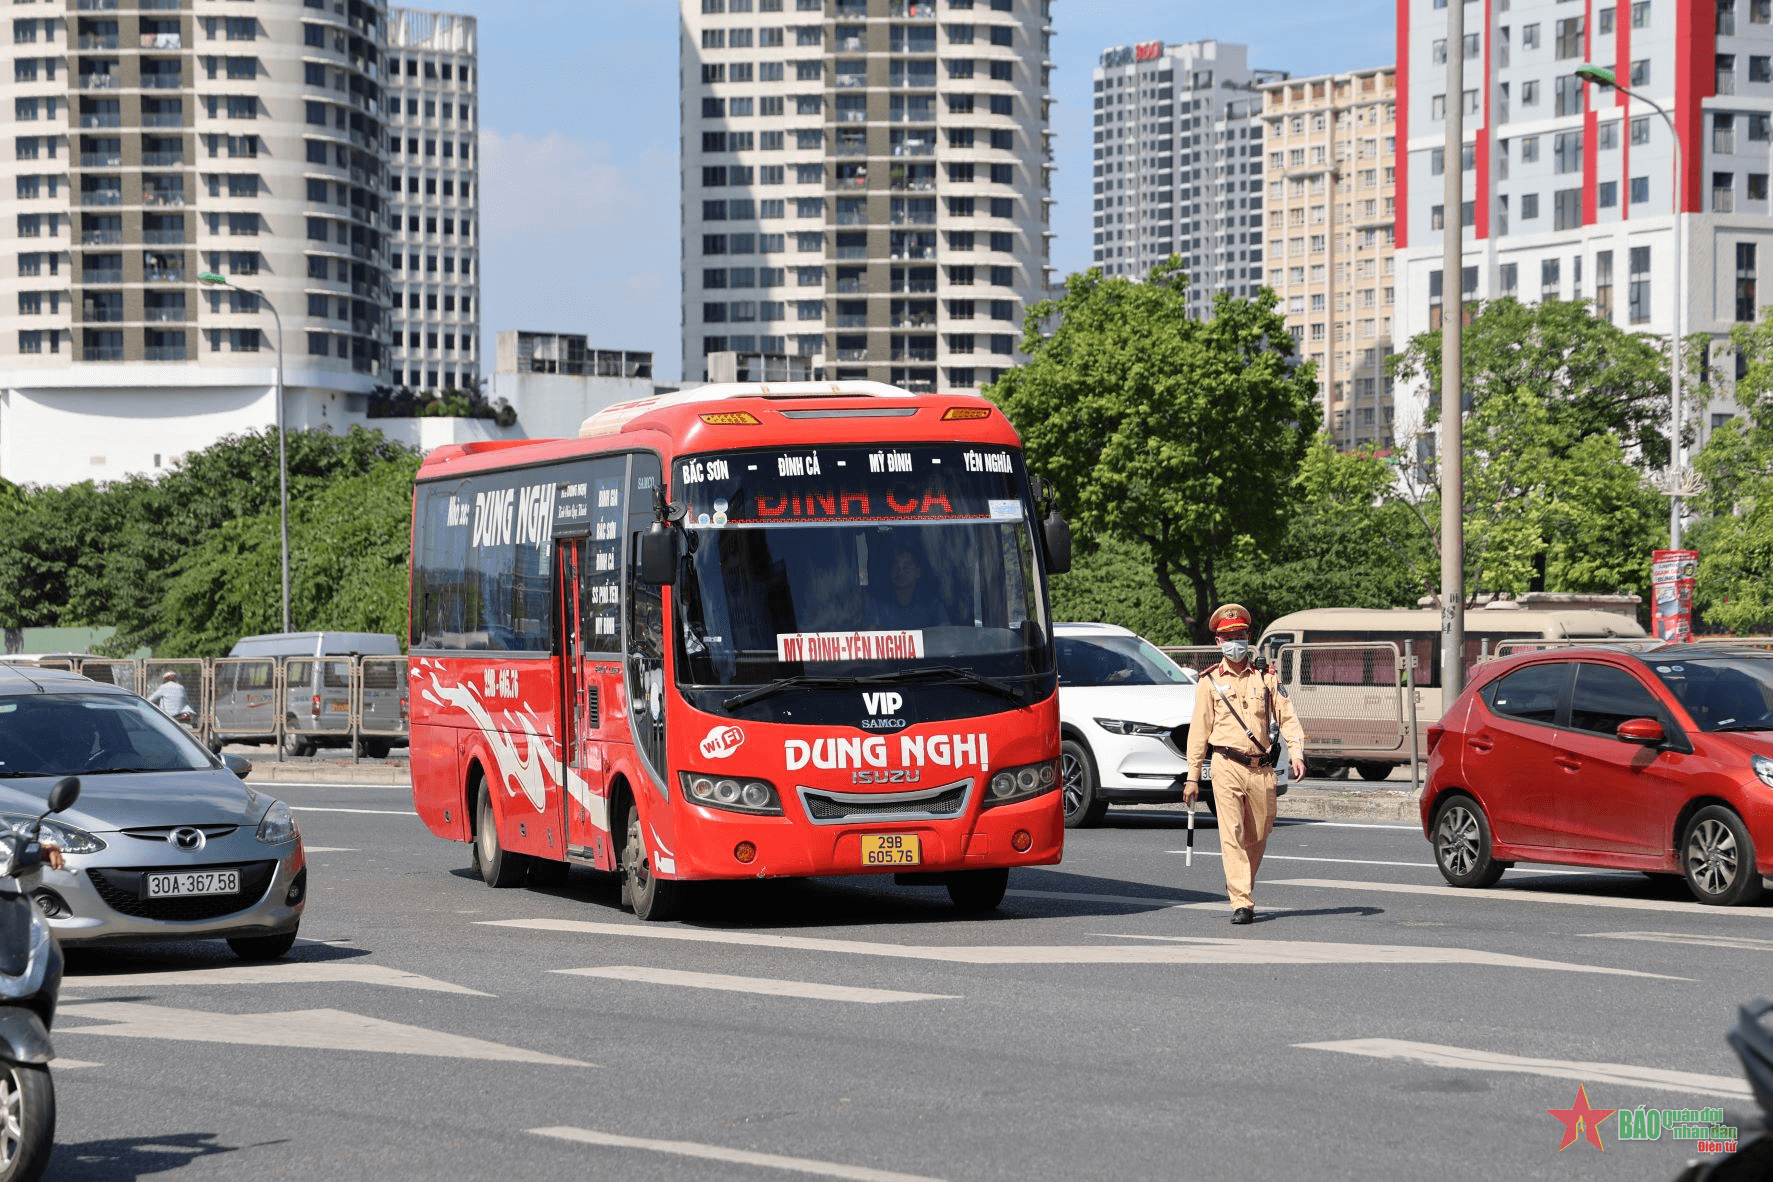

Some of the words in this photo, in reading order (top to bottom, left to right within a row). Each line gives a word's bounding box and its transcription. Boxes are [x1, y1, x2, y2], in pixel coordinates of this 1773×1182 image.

[682, 458, 704, 484] BẮC
[706, 459, 729, 481] SƠN
[777, 454, 804, 477] ĐÌNH
[805, 450, 821, 475] CẢ
[869, 450, 885, 473] MỸ
[887, 450, 912, 472] ĐÌNH
[963, 450, 984, 472] YÊN
[984, 451, 1014, 473] NGHĨA
[472, 488, 515, 548] DUNG
[783, 633, 804, 662] MỸ
[875, 631, 917, 660] NGHĨA
[862, 691, 903, 715] VIP
[861, 718, 906, 729] SAMCO
[784, 736, 888, 771] DUNG
[900, 732, 989, 772] NGHỊ
[851, 769, 921, 784] ISUZU
[878, 836, 903, 849] 29B
[868, 850, 914, 863] 605.76
[151, 872, 237, 895] 30A-367.58
